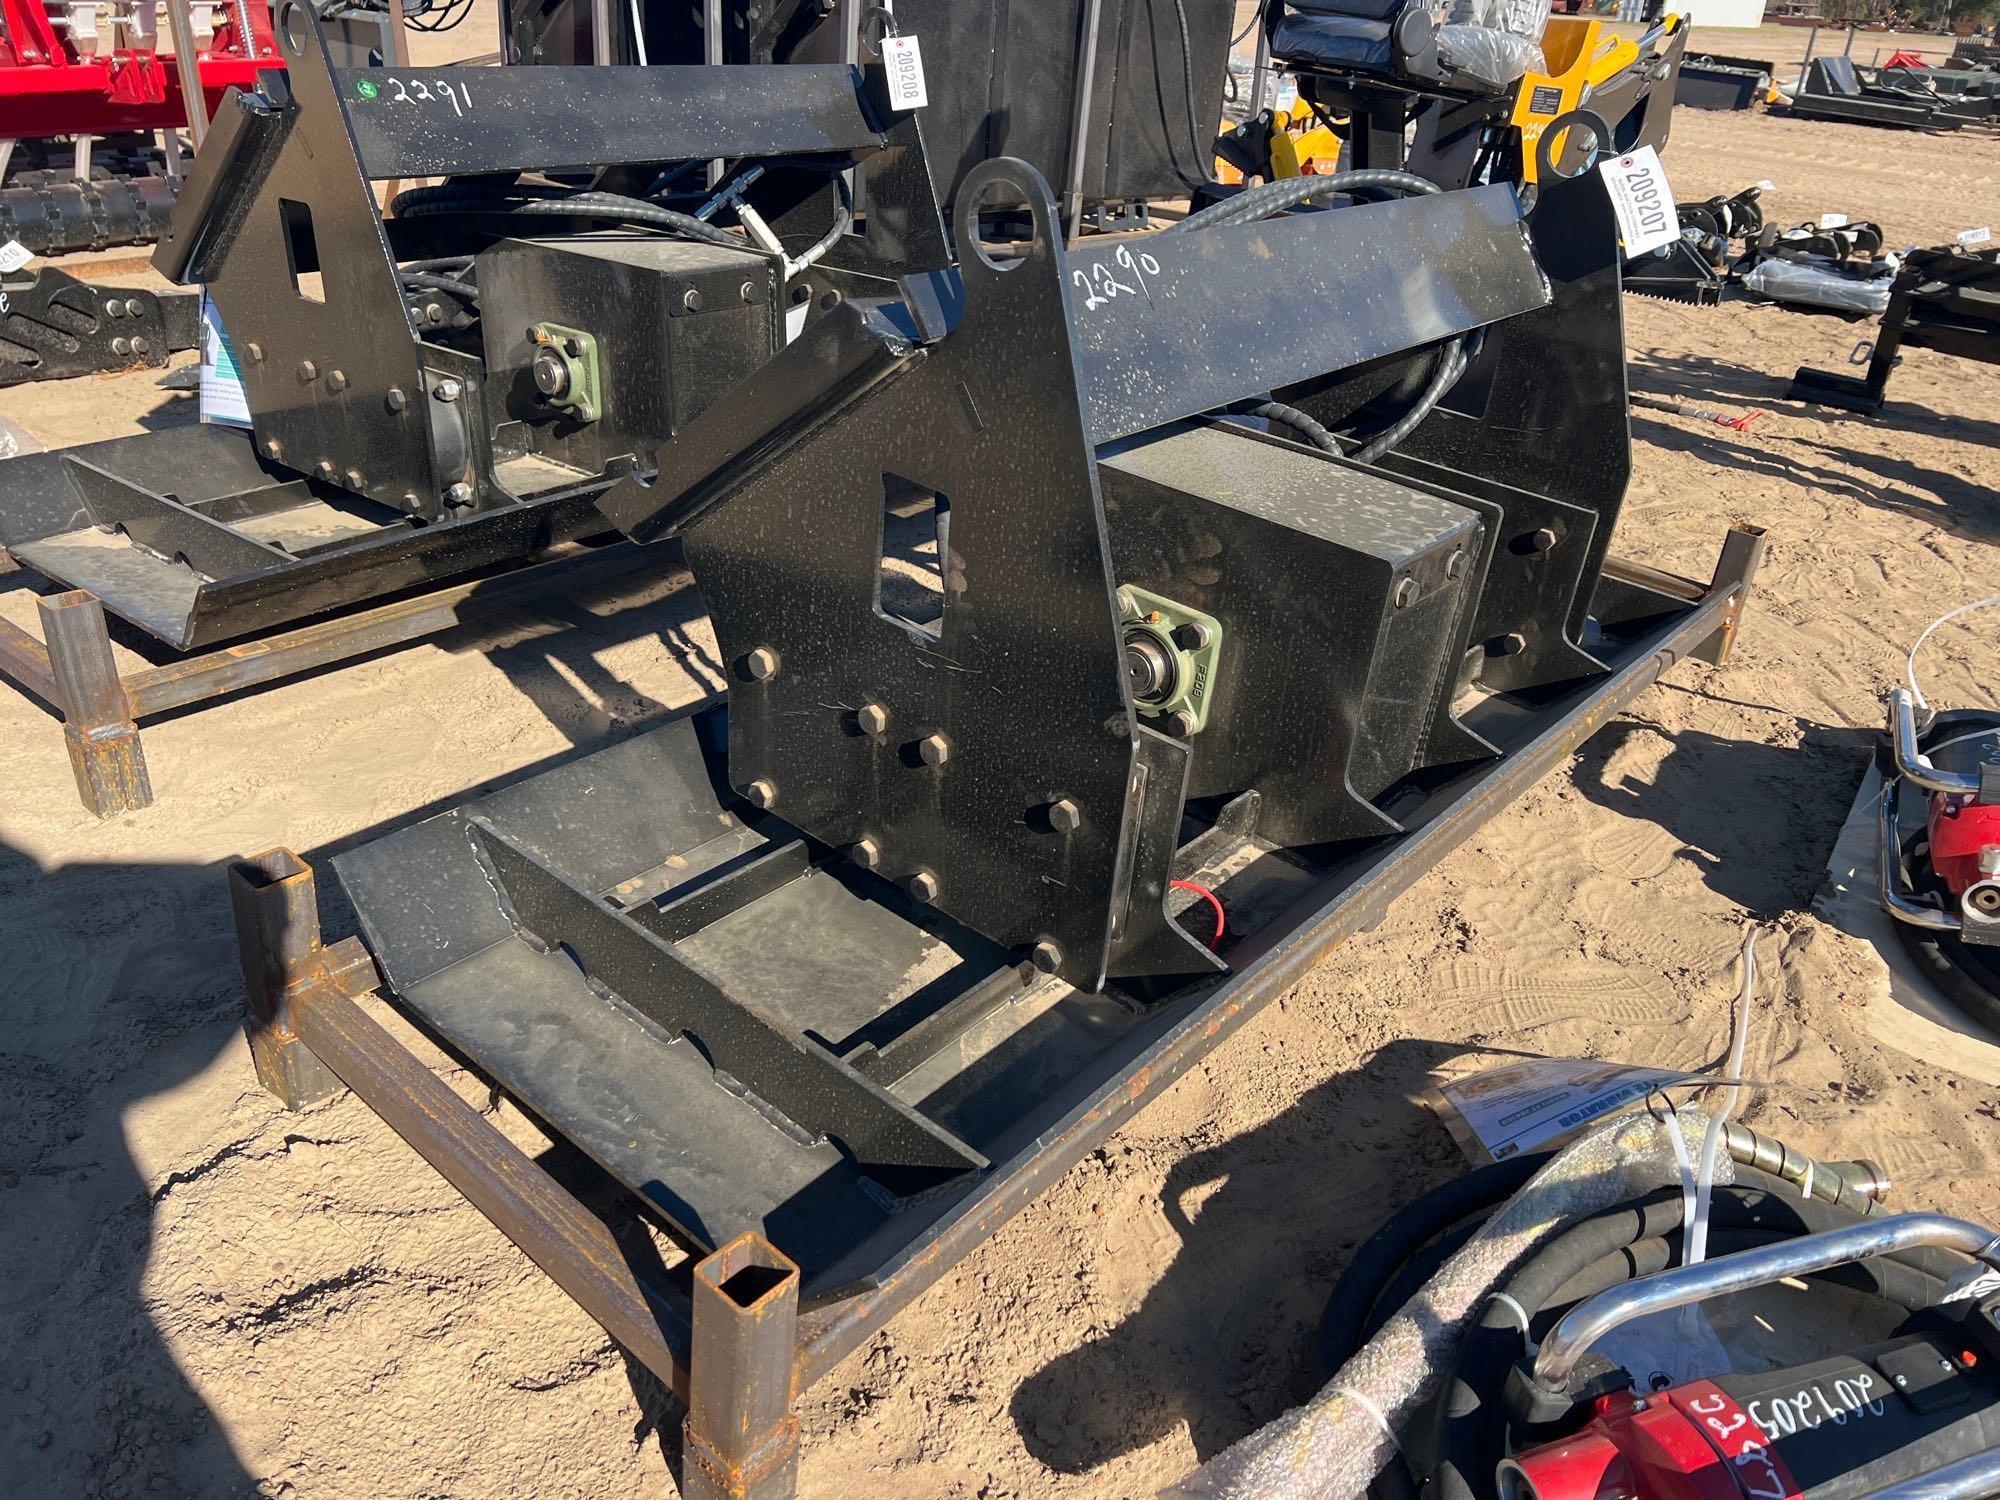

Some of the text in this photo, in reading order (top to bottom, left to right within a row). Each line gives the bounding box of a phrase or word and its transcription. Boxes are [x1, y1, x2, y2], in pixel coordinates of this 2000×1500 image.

[388, 77, 472, 117] 2291
[898, 51, 918, 98] 209208
[1626, 168, 1667, 235] 209207
[1073, 244, 1160, 311] 2290
[1748, 1374, 1884, 1440] 209205
